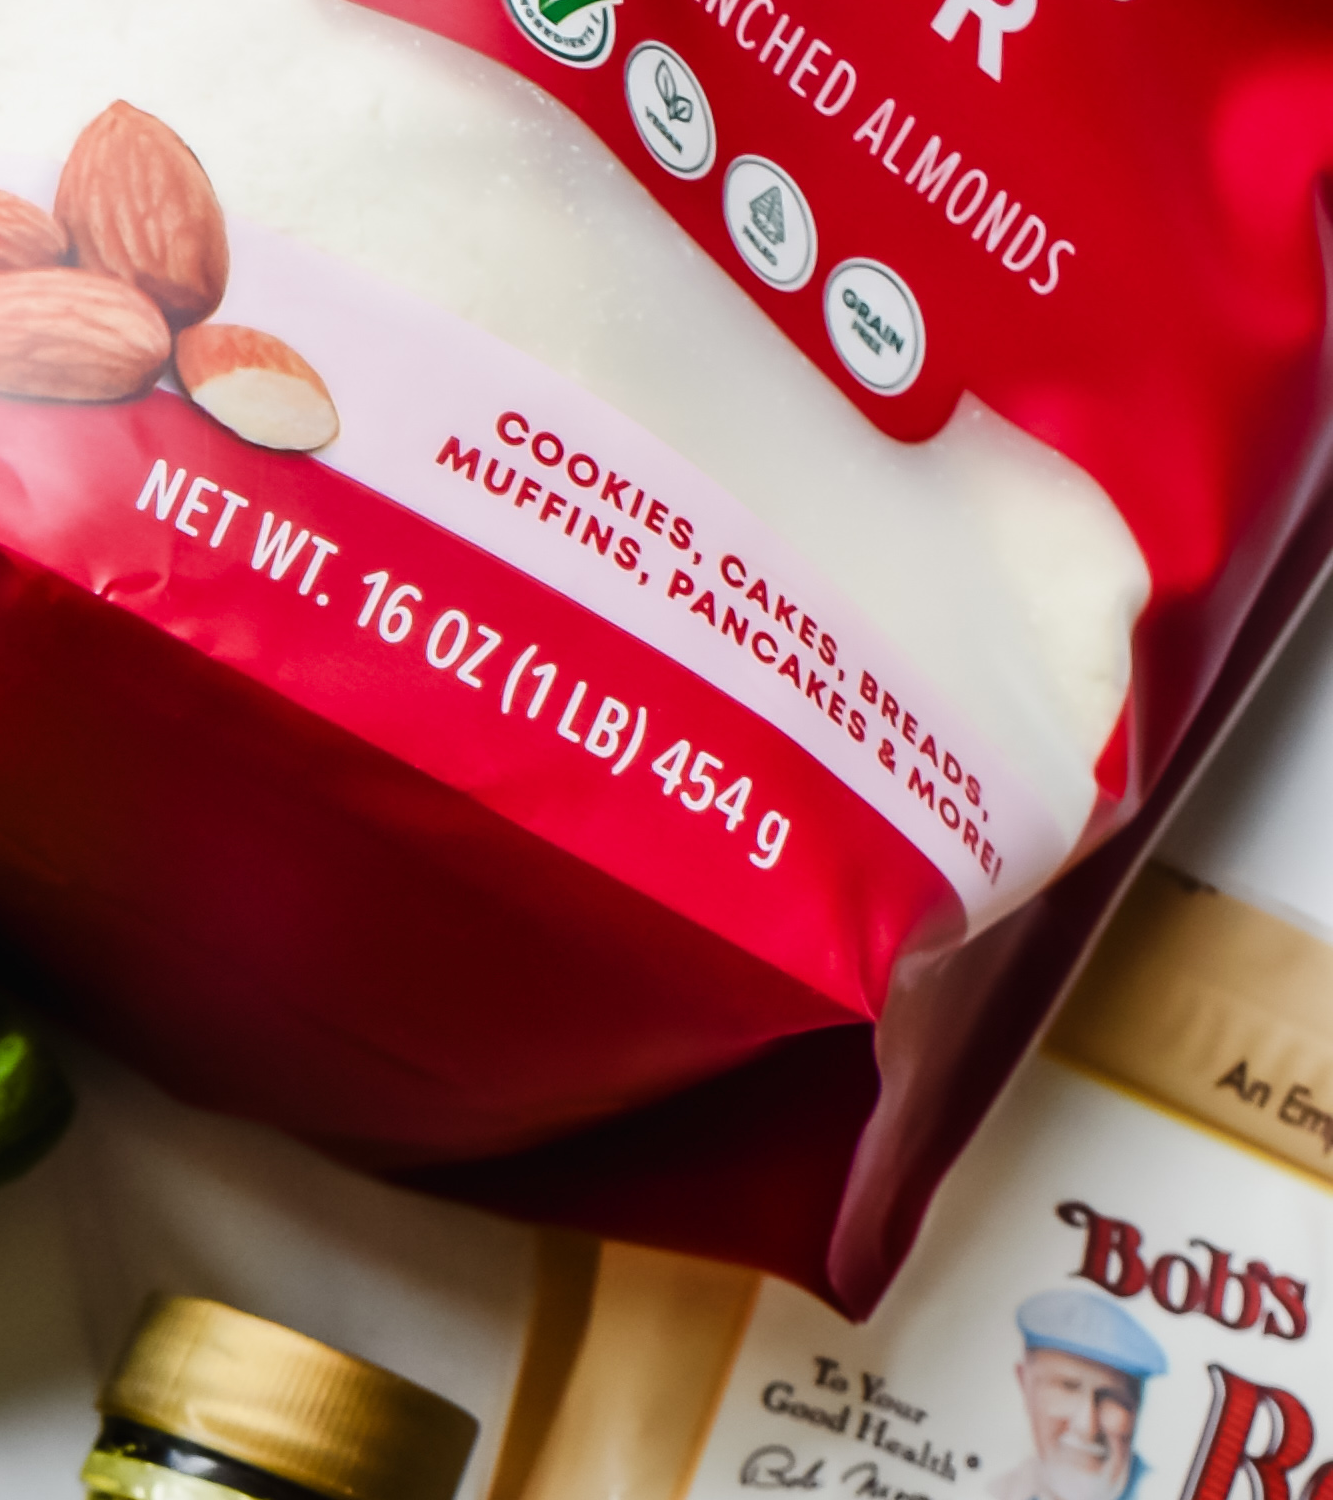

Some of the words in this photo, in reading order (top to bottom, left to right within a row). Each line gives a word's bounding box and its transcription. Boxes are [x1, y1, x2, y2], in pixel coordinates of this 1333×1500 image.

[851, 97, 1079, 297] ALMONDS
[134, 458, 252, 552] NET
[247, 510, 341, 608] WT.
[356, 567, 426, 646] 16
[424, 607, 505, 692] OZ
[499, 643, 560, 720] (1
[554, 680, 649, 776] LB)
[649, 737, 755, 833] 454
[747, 808, 793, 871] g
[435, 435, 652, 588] MUFFINS,
[664, 566, 871, 746] PANCAKES
[875, 737, 901, 776] &
[493, 409, 705, 567] COOKIES,
[717, 552, 849, 683] CAKES,
[1055, 1199, 1309, 1341] Bob's
